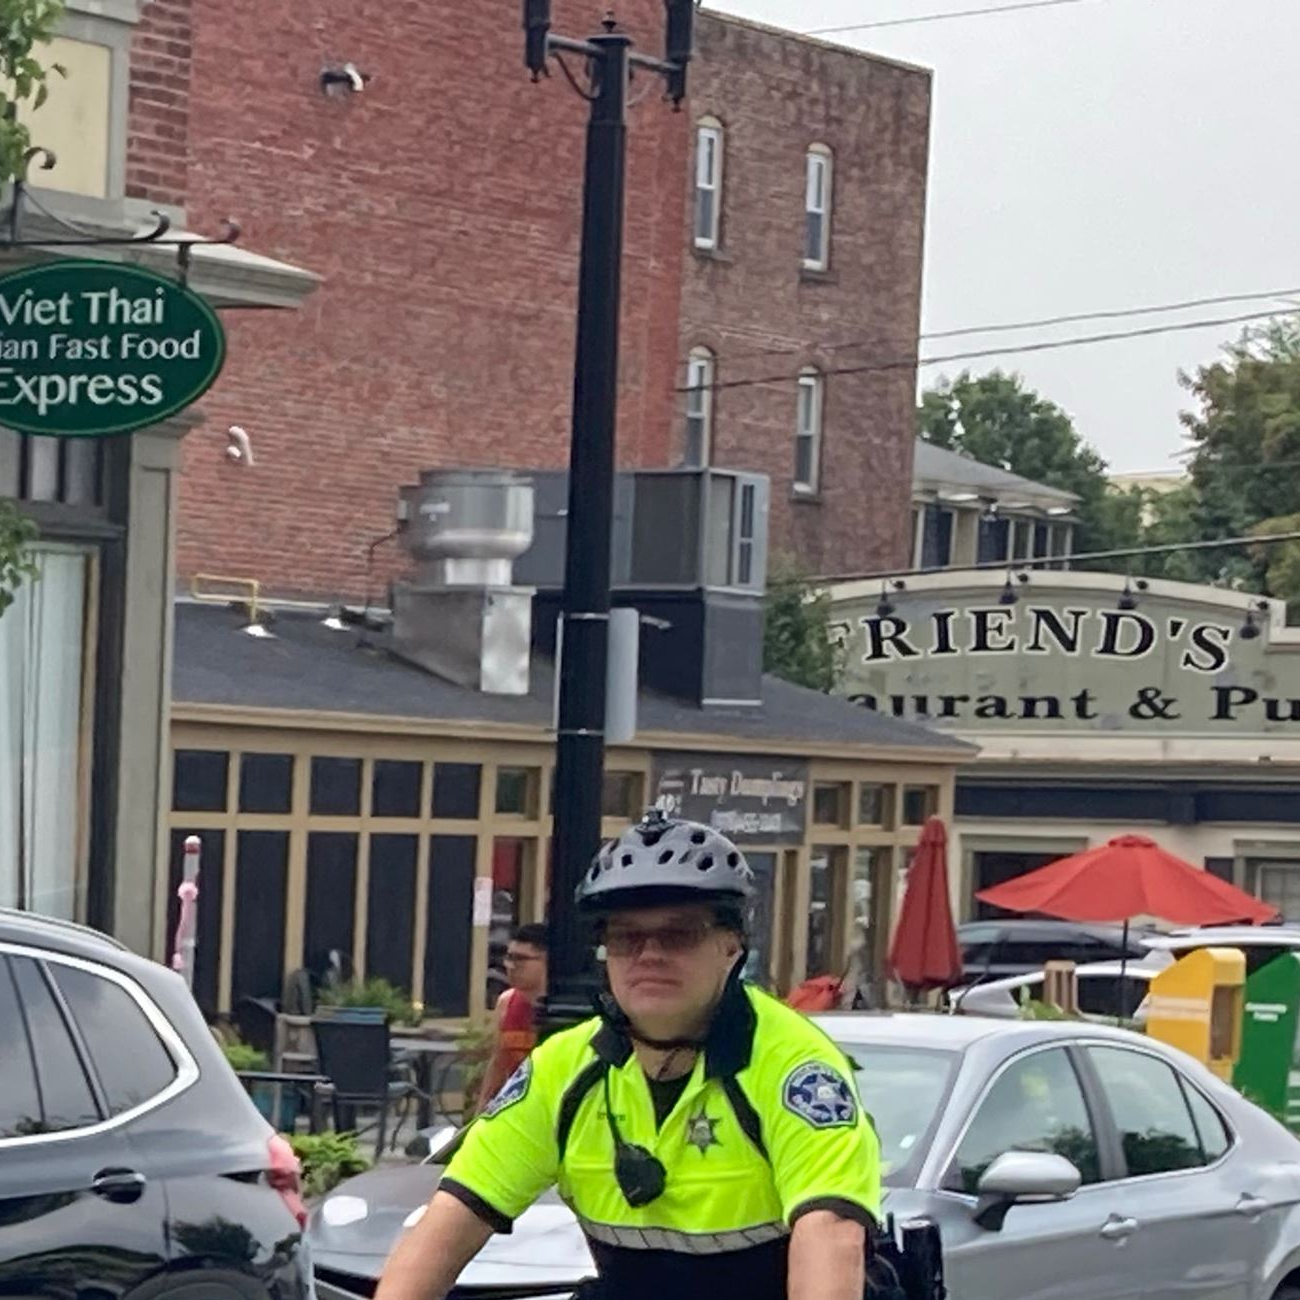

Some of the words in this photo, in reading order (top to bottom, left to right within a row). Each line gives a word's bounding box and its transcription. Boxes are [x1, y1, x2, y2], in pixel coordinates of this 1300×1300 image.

[80, 287, 165, 325] Thai
[49, 333, 111, 360] Fast
[121, 329, 201, 360] Food
[1129, 687, 1181, 720] &
